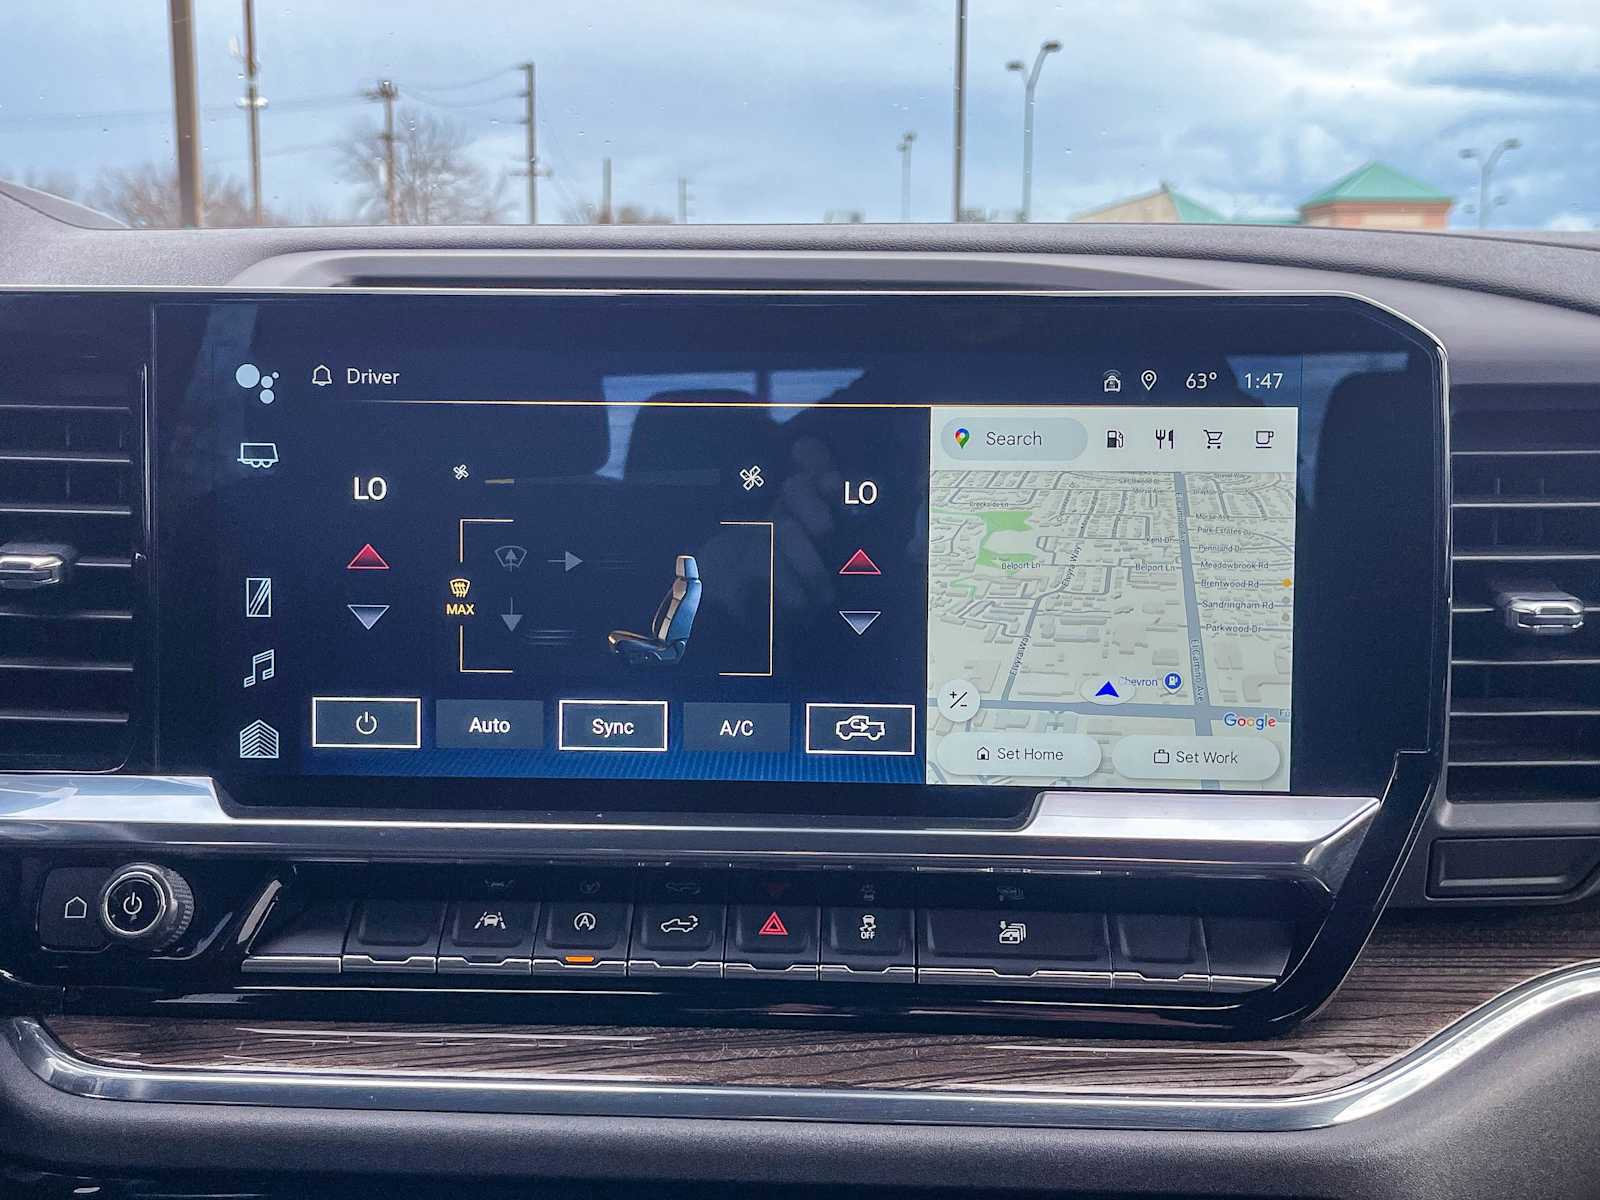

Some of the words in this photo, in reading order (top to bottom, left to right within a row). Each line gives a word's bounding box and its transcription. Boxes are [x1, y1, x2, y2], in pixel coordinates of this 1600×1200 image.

[346, 367, 400, 385] Driver
[1185, 372, 1218, 390] 63°
[1244, 372, 1284, 390] 1:47
[985, 430, 1042, 448] Search
[353, 476, 388, 501] LO
[844, 480, 878, 505] LO
[1198, 526, 1212, 534] Park
[1200, 561, 1256, 570] Meadowbrook
[1257, 562, 1269, 570] Rd
[1200, 578, 1246, 588] Brentwood
[1247, 580, 1260, 589] Rd
[446, 603, 475, 616] MAX
[1201, 600, 1260, 611] Sandringham
[1262, 601, 1275, 611] Rd
[1205, 623, 1249, 634] Parkwood
[1251, 624, 1262, 634] Dr
[1018, 633, 1031, 651] Way
[468, 717, 511, 734] Auto
[591, 718, 635, 738] Sync
[719, 719, 754, 738] A/C
[1224, 713, 1277, 731] Google
[996, 747, 1020, 761] Set
[1024, 747, 1064, 762] Home
[1175, 751, 1200, 764] Set
[1202, 751, 1239, 765] Work
[860, 931, 876, 940] OFF
